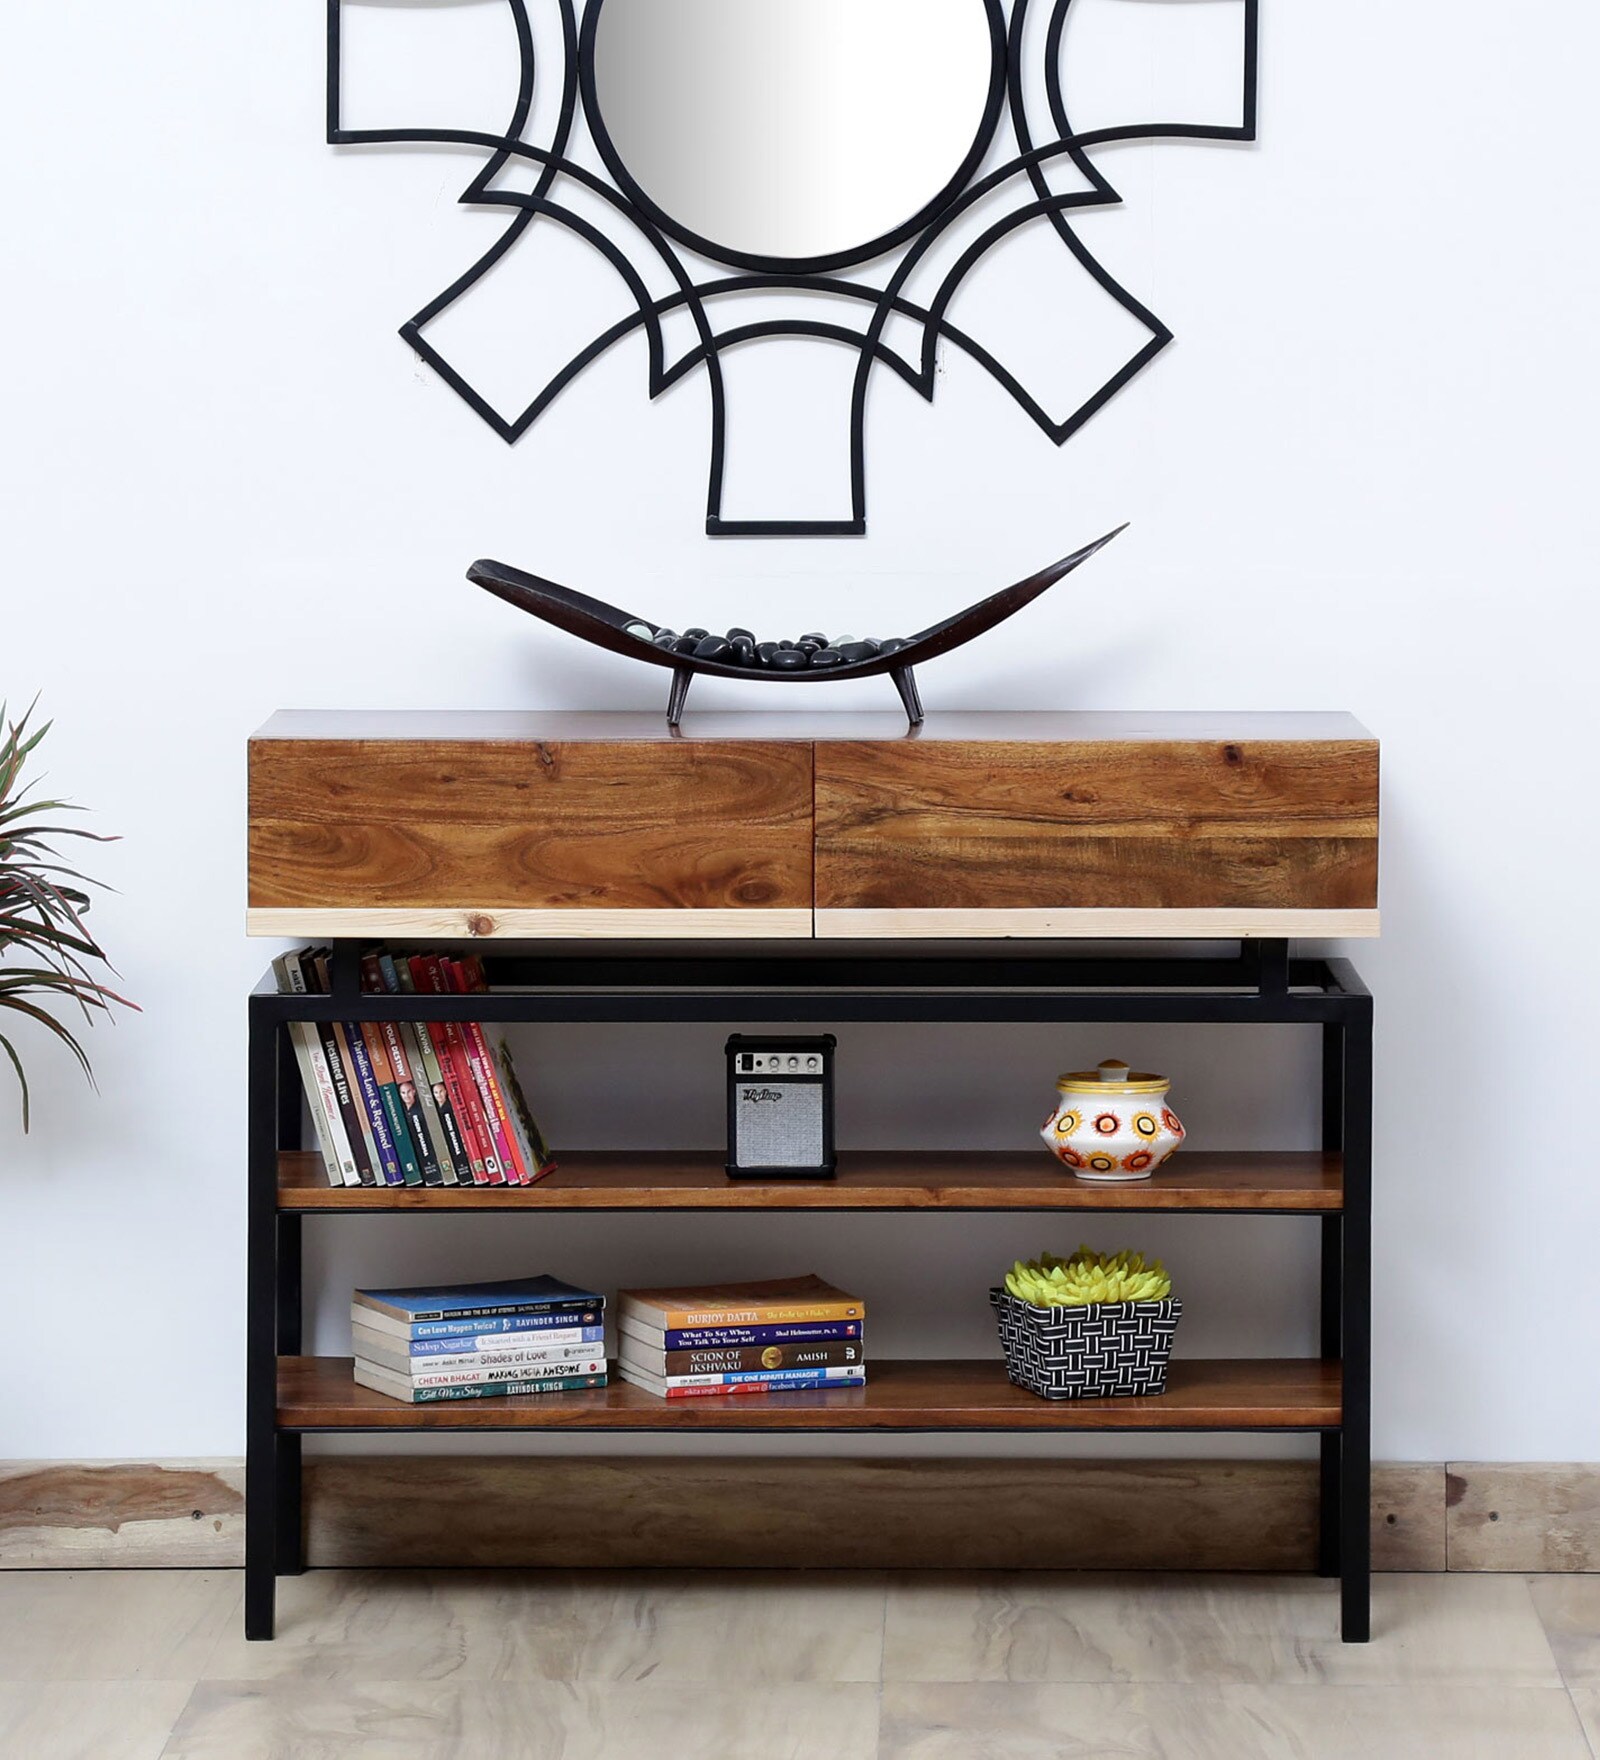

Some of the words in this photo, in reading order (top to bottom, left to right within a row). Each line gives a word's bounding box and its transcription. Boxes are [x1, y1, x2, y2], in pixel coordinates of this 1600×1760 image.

[384, 1023, 396, 1045] YOUR
[390, 1045, 405, 1077] DESTINY
[352, 1040, 371, 1077] Paradise
[325, 1039, 343, 1080] Destined
[336, 1080, 350, 1105] Lives
[363, 1077, 376, 1098] Lost
[369, 1108, 391, 1150] Regained
[412, 1114, 421, 1132] ROBIN
[417, 1132, 428, 1157] SHARMA
[443, 1112, 454, 1131] ROBIN
[449, 1131, 460, 1155] SHARMA
[516, 1317, 553, 1327] RAVINDER
[555, 1315, 579, 1324] SINGH
[687, 1313, 724, 1324] DURJOY
[727, 1311, 759, 1322] DATTA
[418, 1327, 431, 1335] Can
[431, 1326, 447, 1334] Love
[447, 1324, 473, 1333] Happen
[473, 1321, 497, 1330] Twice?
[682, 1331, 702, 1339] What
[715, 1330, 728, 1338] Say
[487, 1335, 511, 1344] Started
[532, 1332, 552, 1341] Friend
[678, 1339, 692, 1347] You
[694, 1338, 710, 1346] Talk
[711, 1337, 721, 1345] To
[722, 1336, 739, 1344] Your
[740, 1335, 756, 1343] Self
[480, 1353, 513, 1365] Shades
[515, 1352, 524, 1362] of
[526, 1350, 548, 1361] Love
[690, 1351, 725, 1363] SCION
[726, 1350, 742, 1360] OF
[796, 1351, 828, 1362] AMISH
[488, 1369, 519, 1380] MAKING
[543, 1363, 581, 1377] AWESOME
[690, 1361, 742, 1373] IKSHVAKU
[418, 1376, 448, 1385] CHETAN
[450, 1373, 481, 1383] BHAGAT
[760, 1373, 784, 1381] MINUTE
[785, 1371, 820, 1380] MANAGER
[506, 1383, 540, 1395] RAVINDER
[542, 1381, 564, 1392] SINGH
[768, 1380, 796, 1390] facebook
